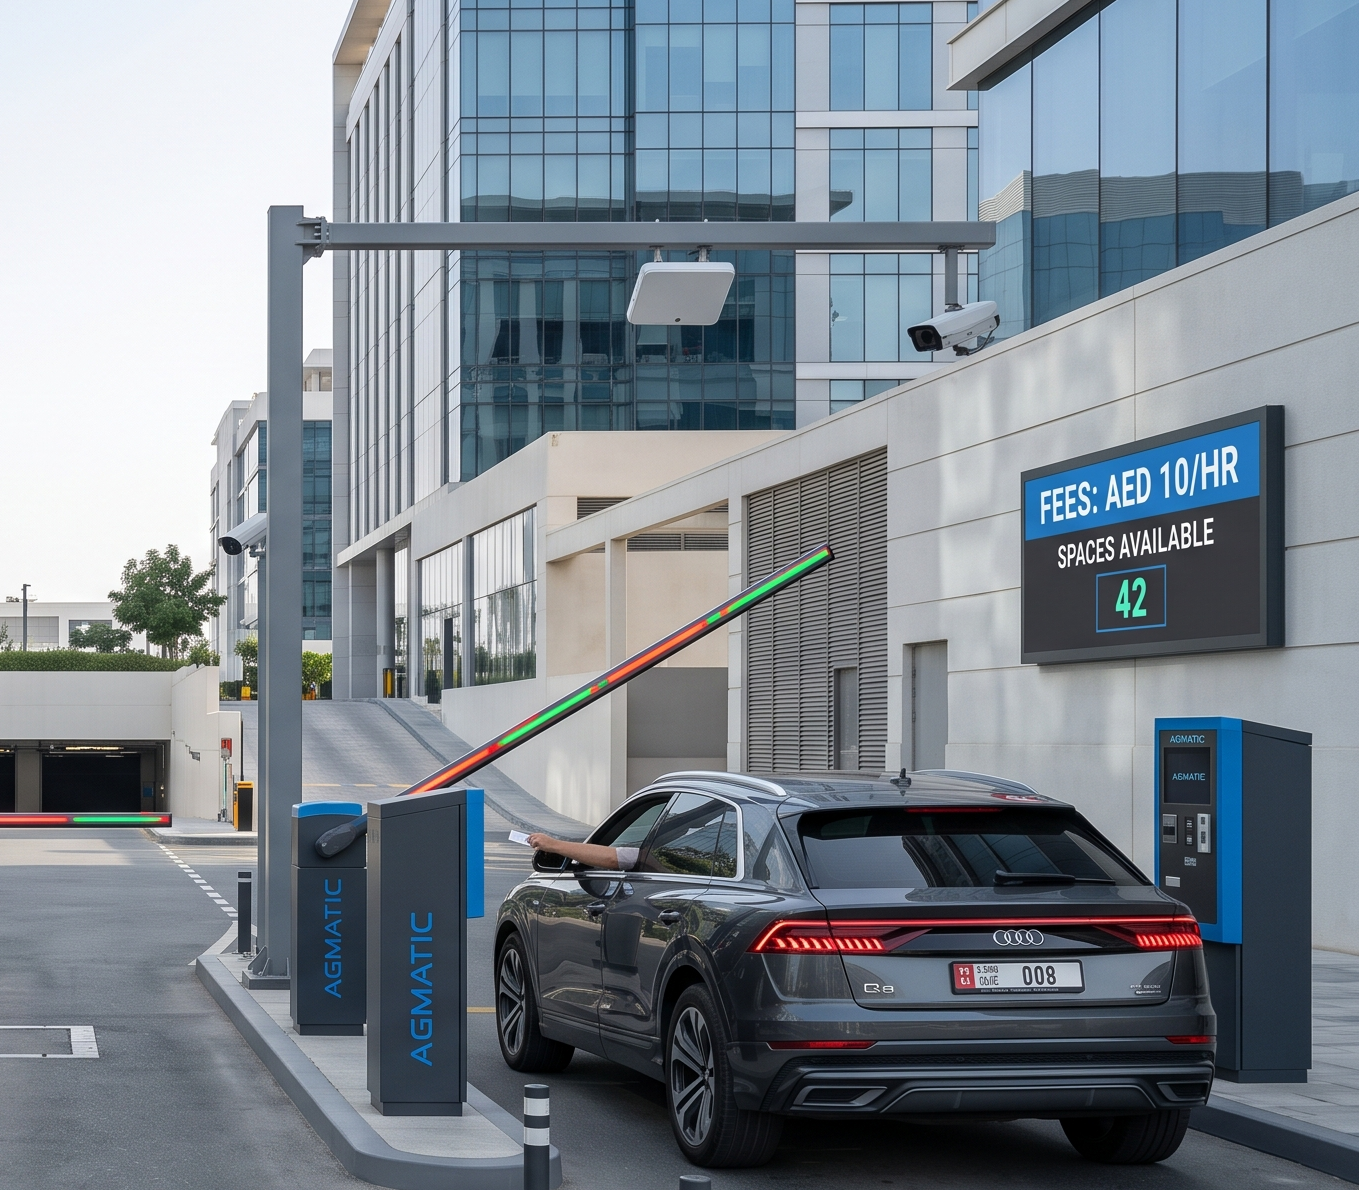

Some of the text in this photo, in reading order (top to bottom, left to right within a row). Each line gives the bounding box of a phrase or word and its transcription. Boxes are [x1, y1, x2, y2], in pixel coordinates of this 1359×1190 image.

[1040, 445, 1239, 525] FEES: AED 10/HR
[1057, 517, 1215, 569] SPACES AVAILABLE
[1115, 576, 1147, 618] 42
[1169, 735, 1205, 744] AGMATIC
[324, 879, 341, 998] AGMATIC
[410, 912, 432, 1066] AGMATIC
[863, 983, 894, 994] Q8
[1022, 965, 1057, 986] 008
